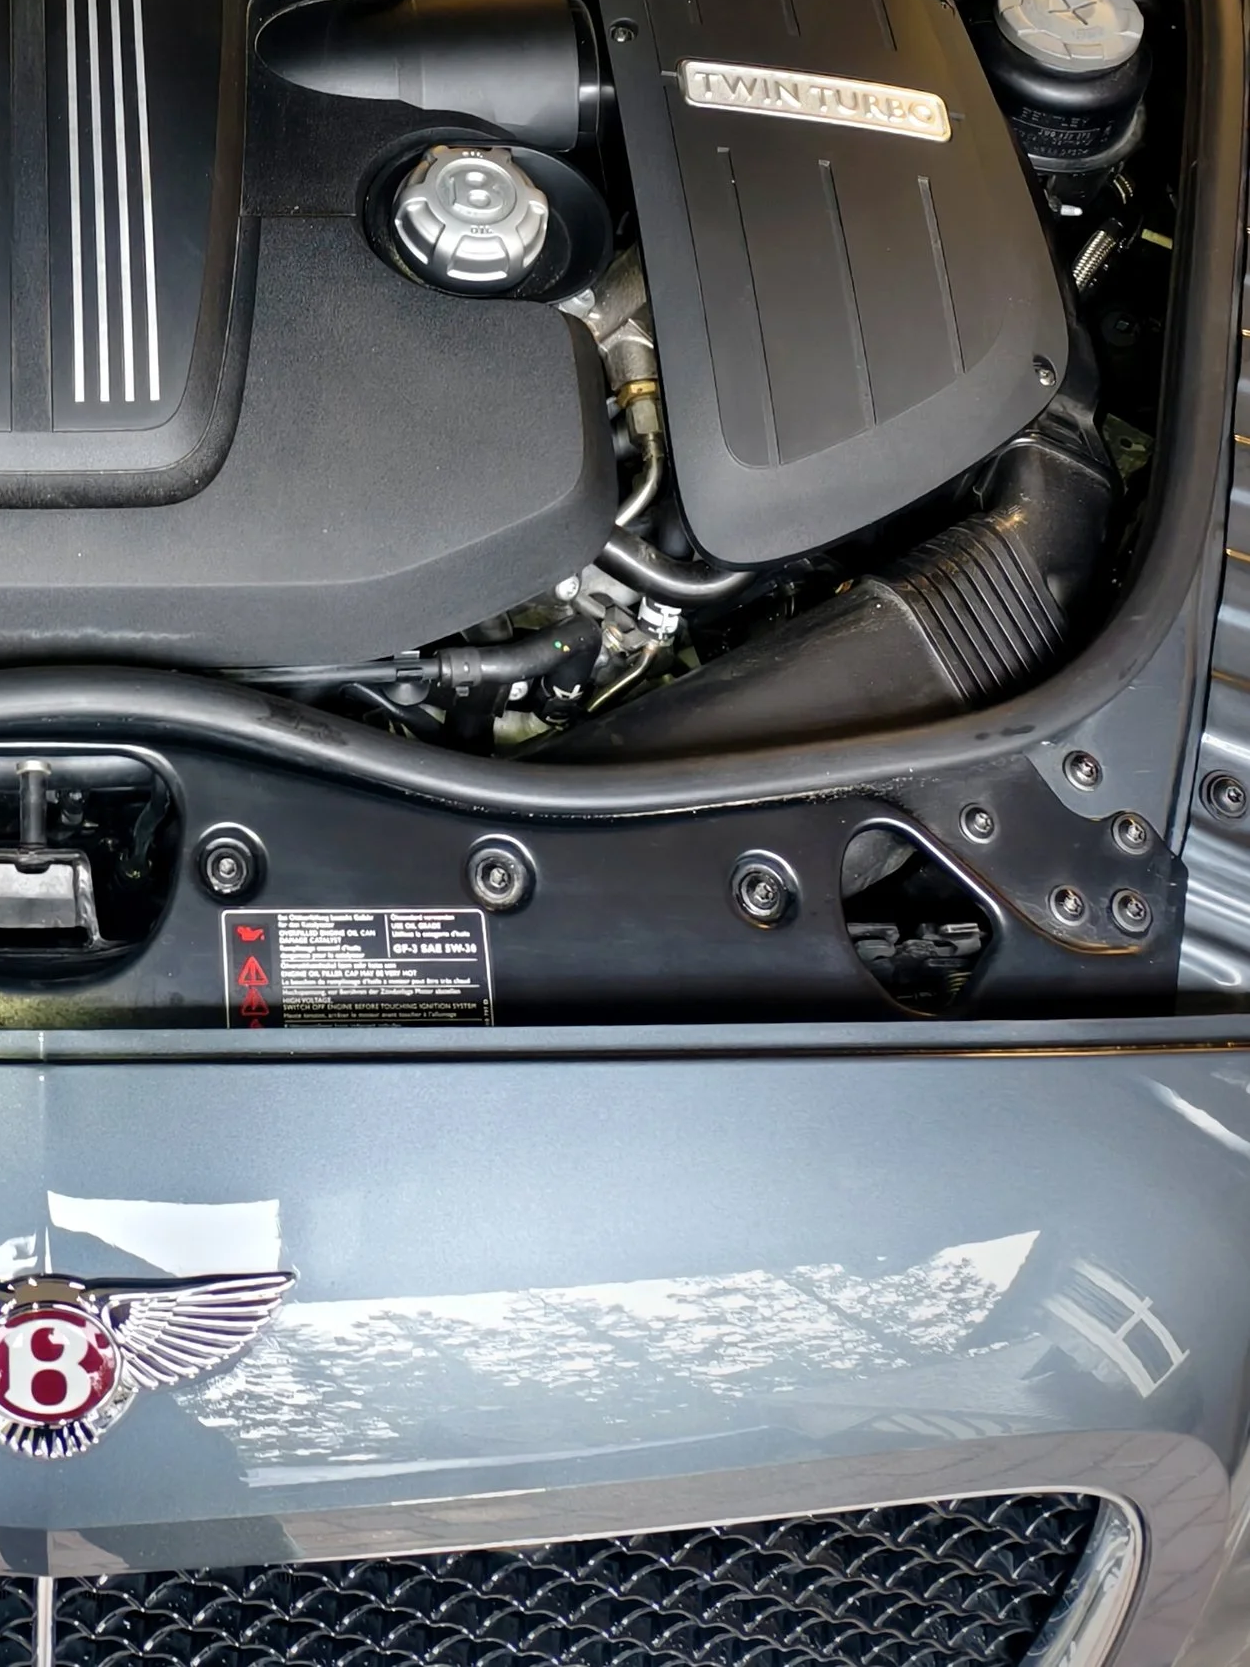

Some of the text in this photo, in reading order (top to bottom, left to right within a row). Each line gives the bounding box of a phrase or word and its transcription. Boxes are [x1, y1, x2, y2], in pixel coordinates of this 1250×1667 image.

[693, 71, 934, 128] TWIN TURBO
[279, 929, 318, 937] OVERFILLED
[420, 943, 442, 954] SAE
[384, 969, 401, 977] VERY
[402, 969, 417, 977] HOT
